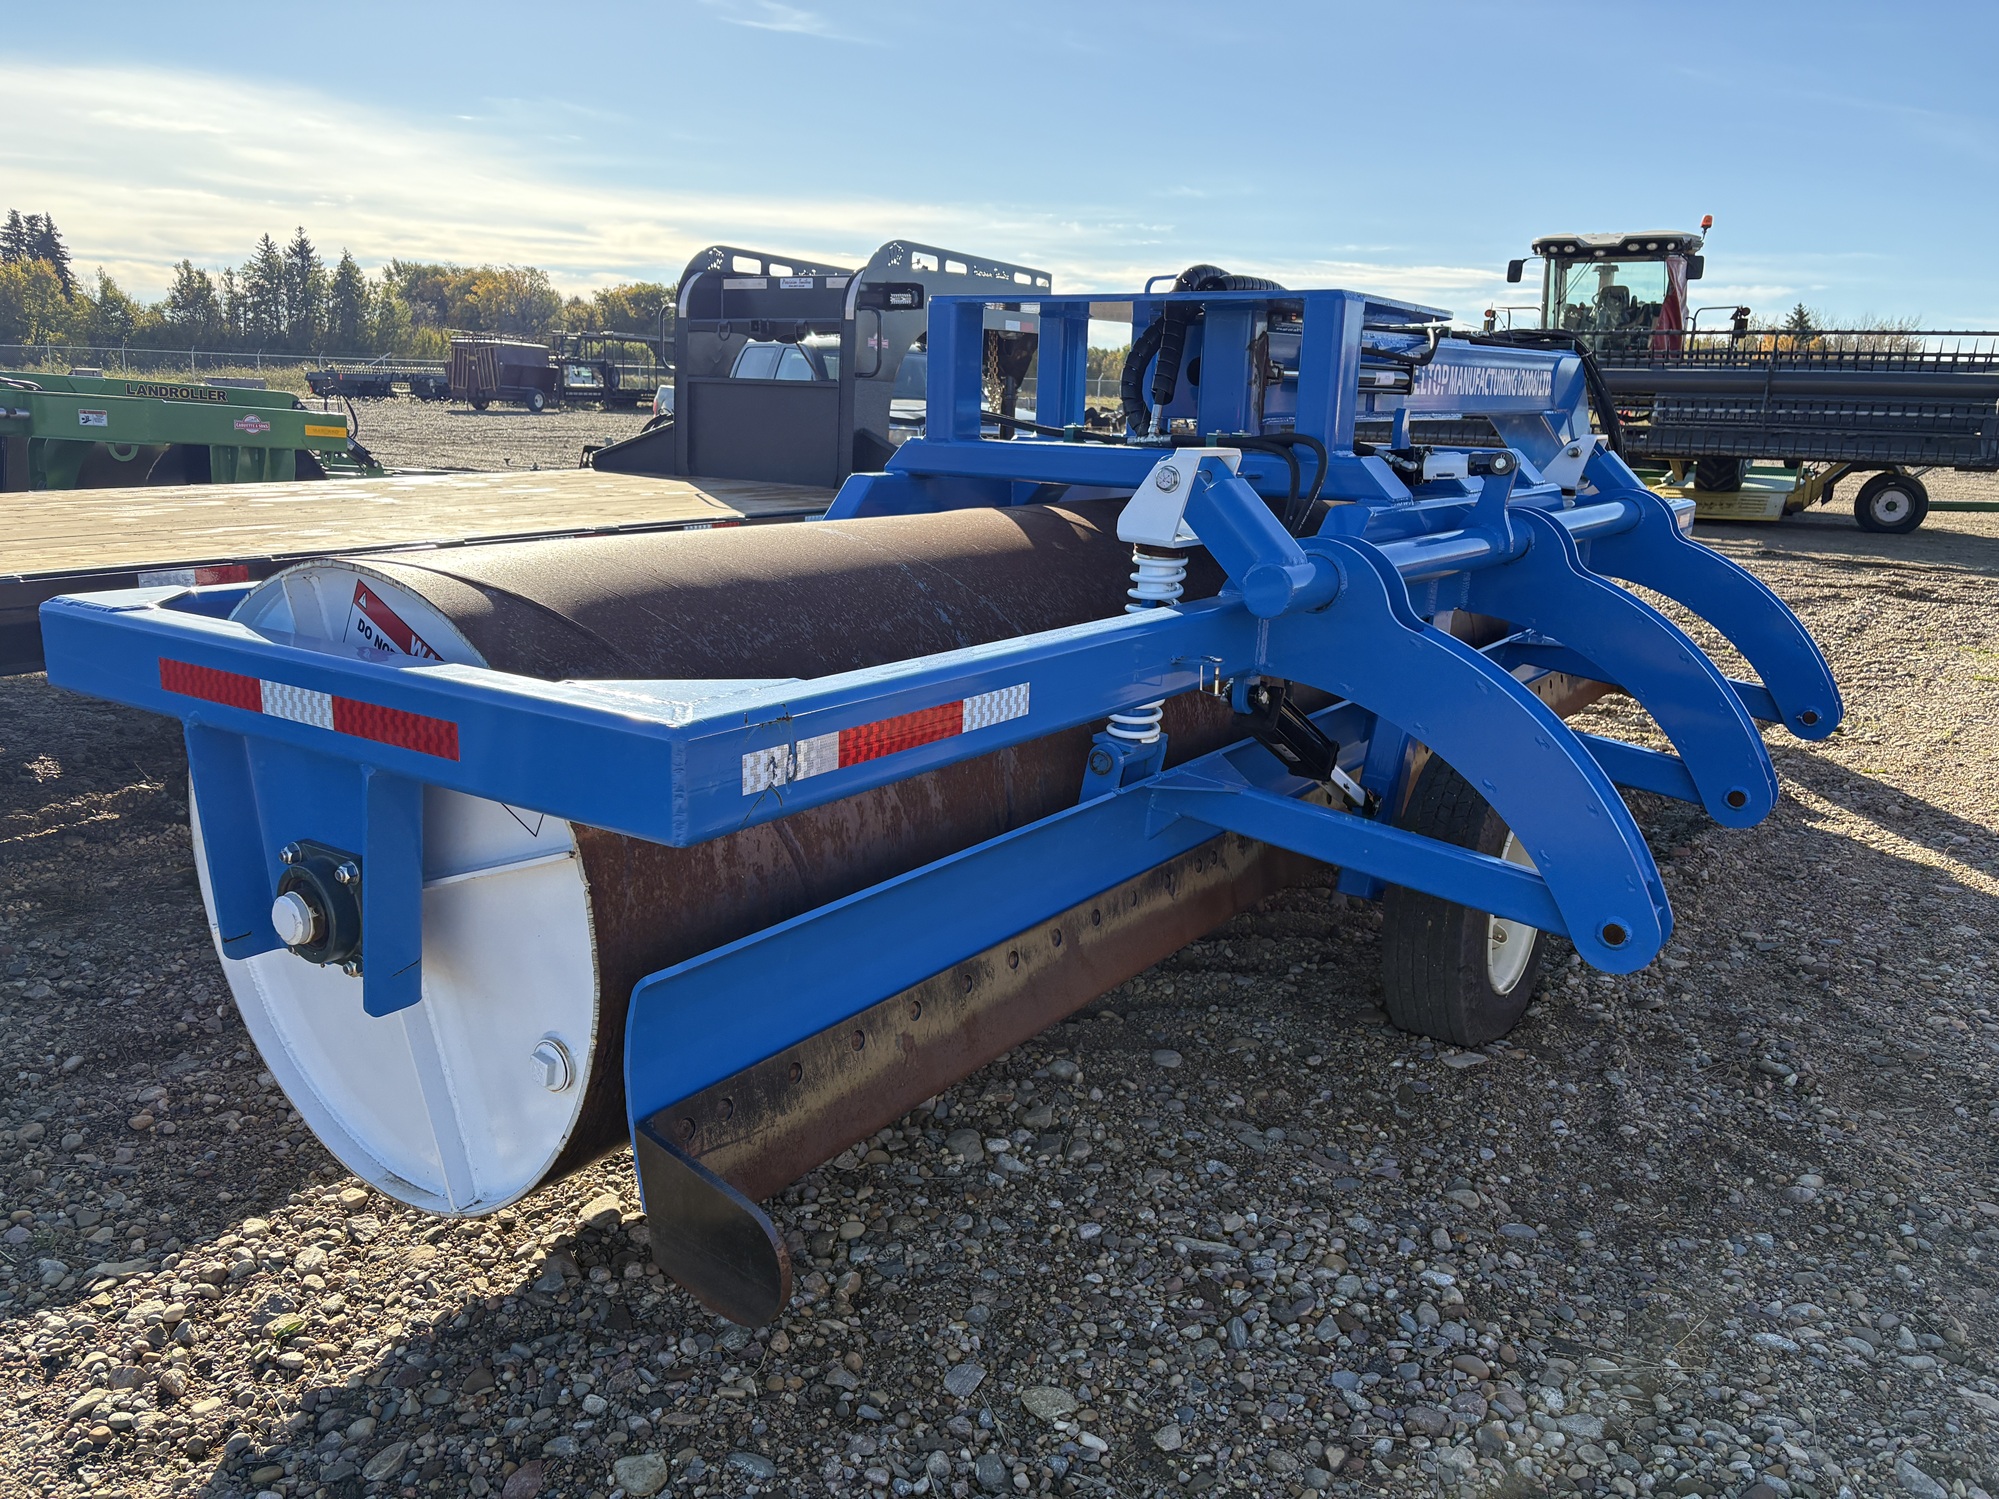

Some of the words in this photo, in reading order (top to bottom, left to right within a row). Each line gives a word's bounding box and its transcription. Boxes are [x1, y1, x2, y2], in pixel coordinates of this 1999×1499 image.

[125, 382, 229, 402] LANDROLLER
[1448, 365, 1518, 397] MANUFACTURING
[357, 617, 373, 640] DO
[374, 634, 396, 653] NO
